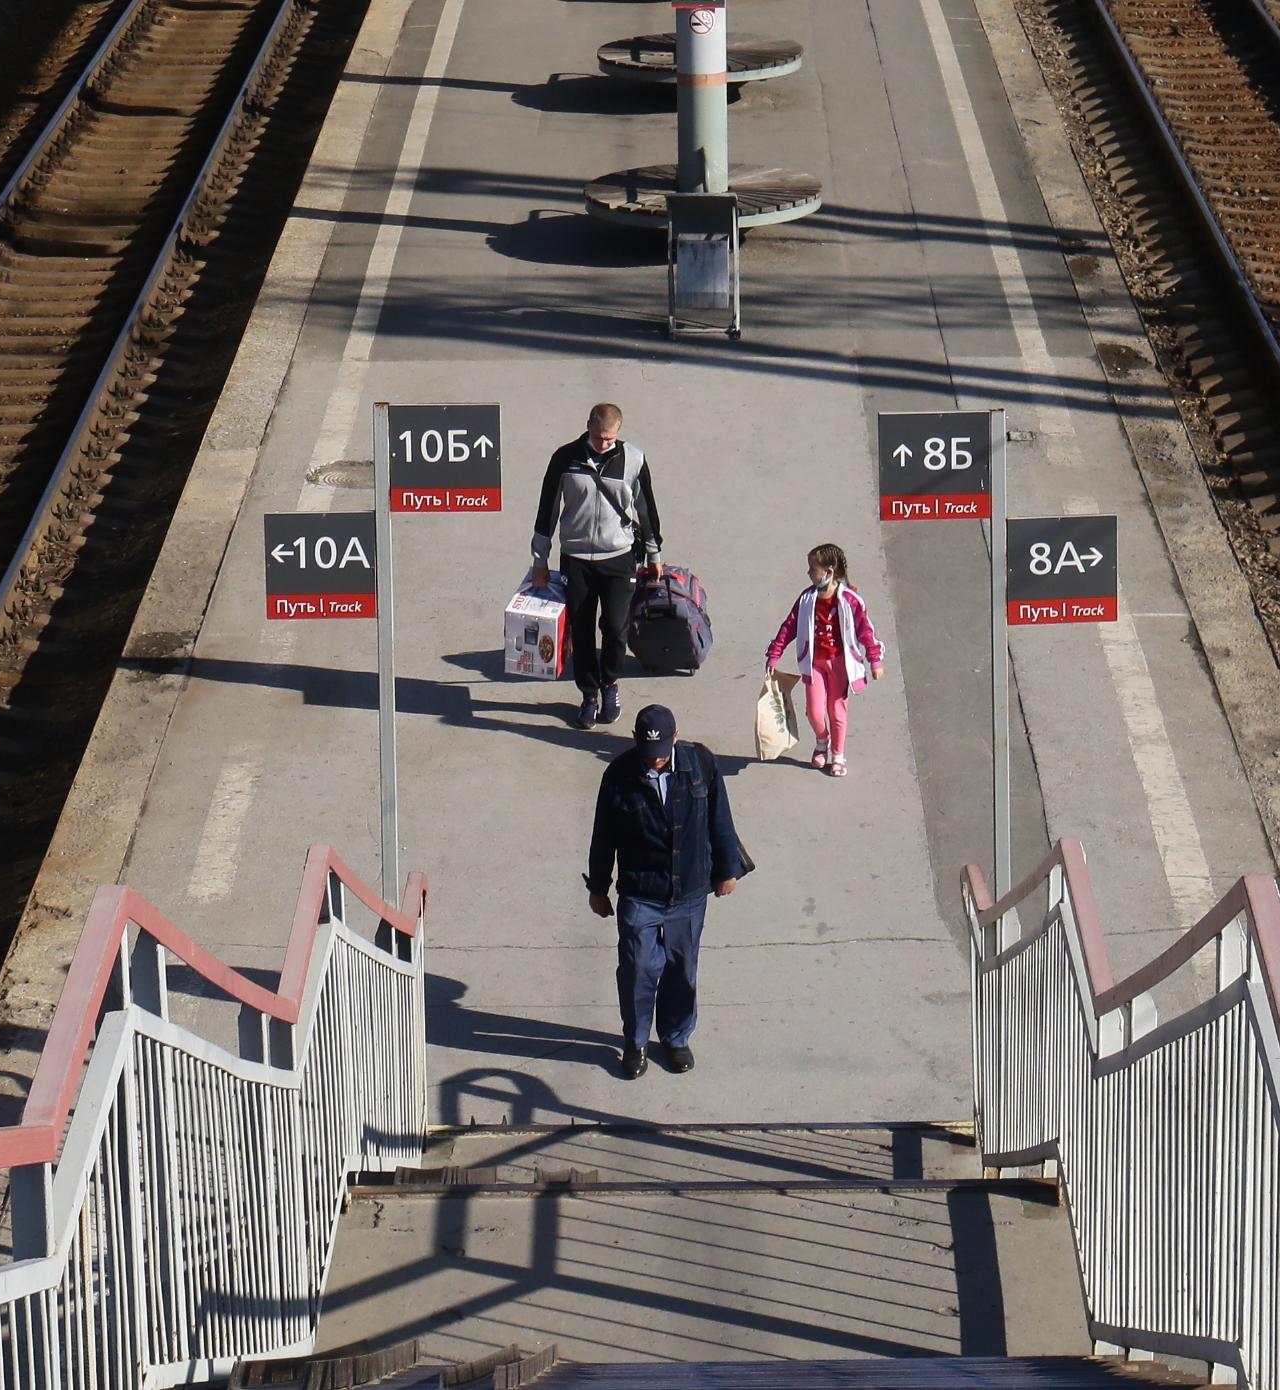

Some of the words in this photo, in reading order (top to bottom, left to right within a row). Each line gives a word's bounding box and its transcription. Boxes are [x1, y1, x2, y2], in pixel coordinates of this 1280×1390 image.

[398, 429, 471, 463] 10Б
[923, 437, 973, 471] 8Б
[402, 492, 442, 509] Путь
[455, 494, 489, 506] Track
[892, 501, 931, 518] Путь
[944, 502, 978, 514] Track
[292, 536, 371, 569] 10А
[1029, 541, 1086, 576] 8А
[276, 599, 316, 617] Путь
[329, 600, 363, 613] Track
[1019, 604, 1059, 621] Путь
[1071, 604, 1105, 617] Track
